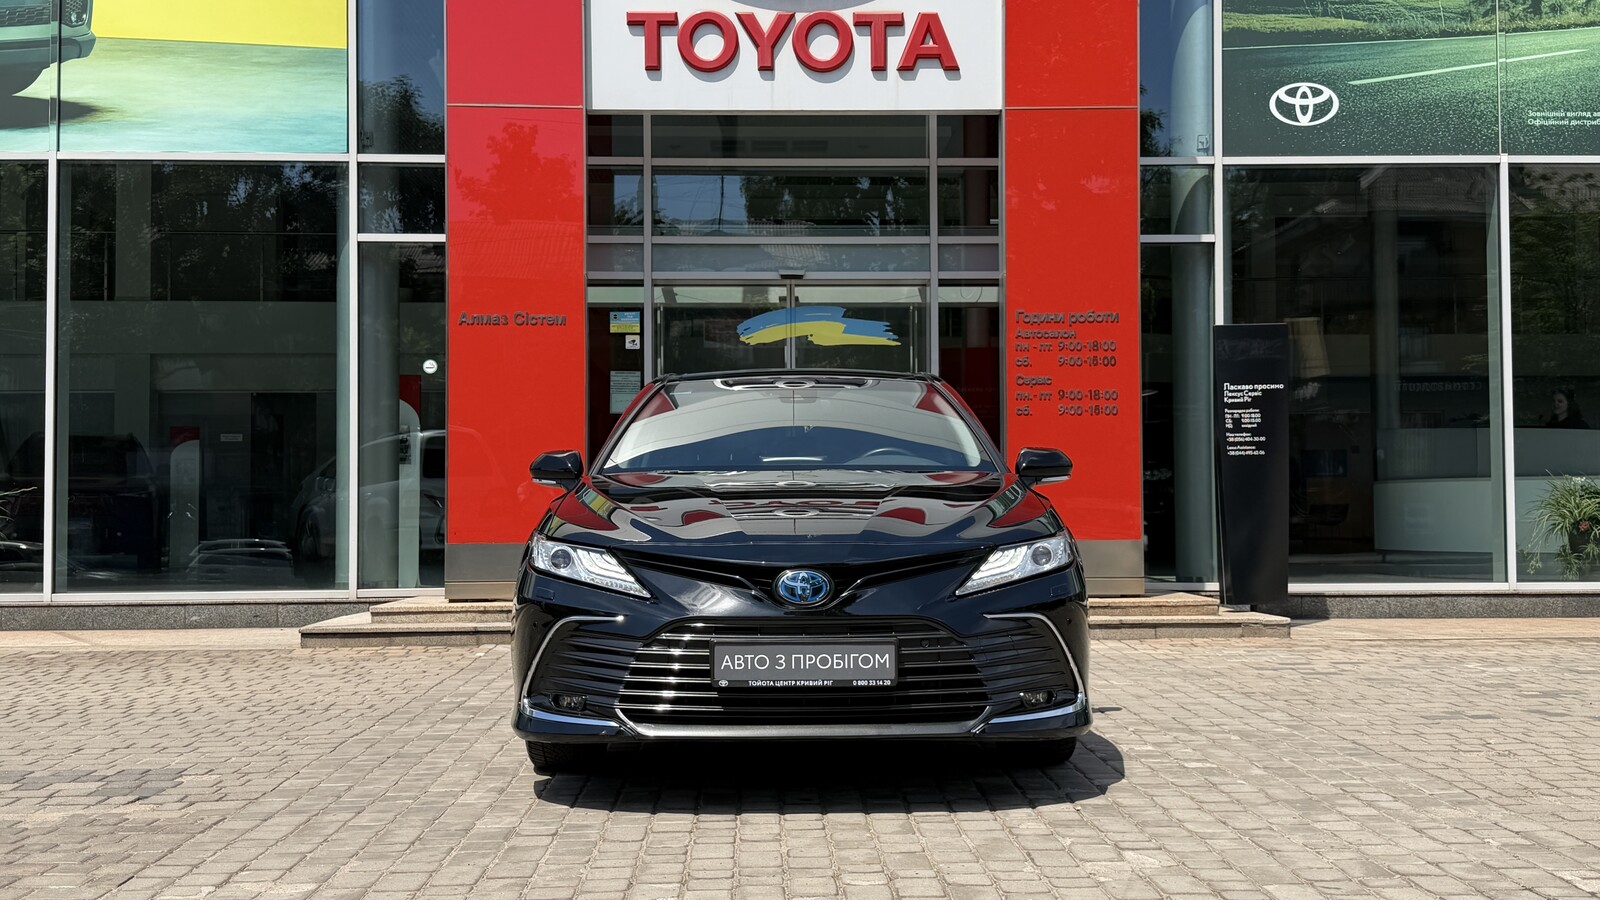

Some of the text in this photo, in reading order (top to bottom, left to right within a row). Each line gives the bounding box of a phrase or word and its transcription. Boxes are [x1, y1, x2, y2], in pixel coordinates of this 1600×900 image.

[626, 10, 960, 73] TOYOTA
[1527, 118, 1569, 126] Офіційний
[459, 311, 567, 326] Алмаз Сістем
[1015, 310, 1119, 327] Години роботи
[1015, 328, 1076, 339] Автосалон
[1015, 356, 1033, 367] сб.
[1015, 374, 1052, 388] Сервіс
[1253, 383, 1285, 391] просимо
[1015, 405, 1033, 416] сб.
[720, 654, 770, 670] АВТО
[791, 653, 890, 670] ПРОБІГОМ
